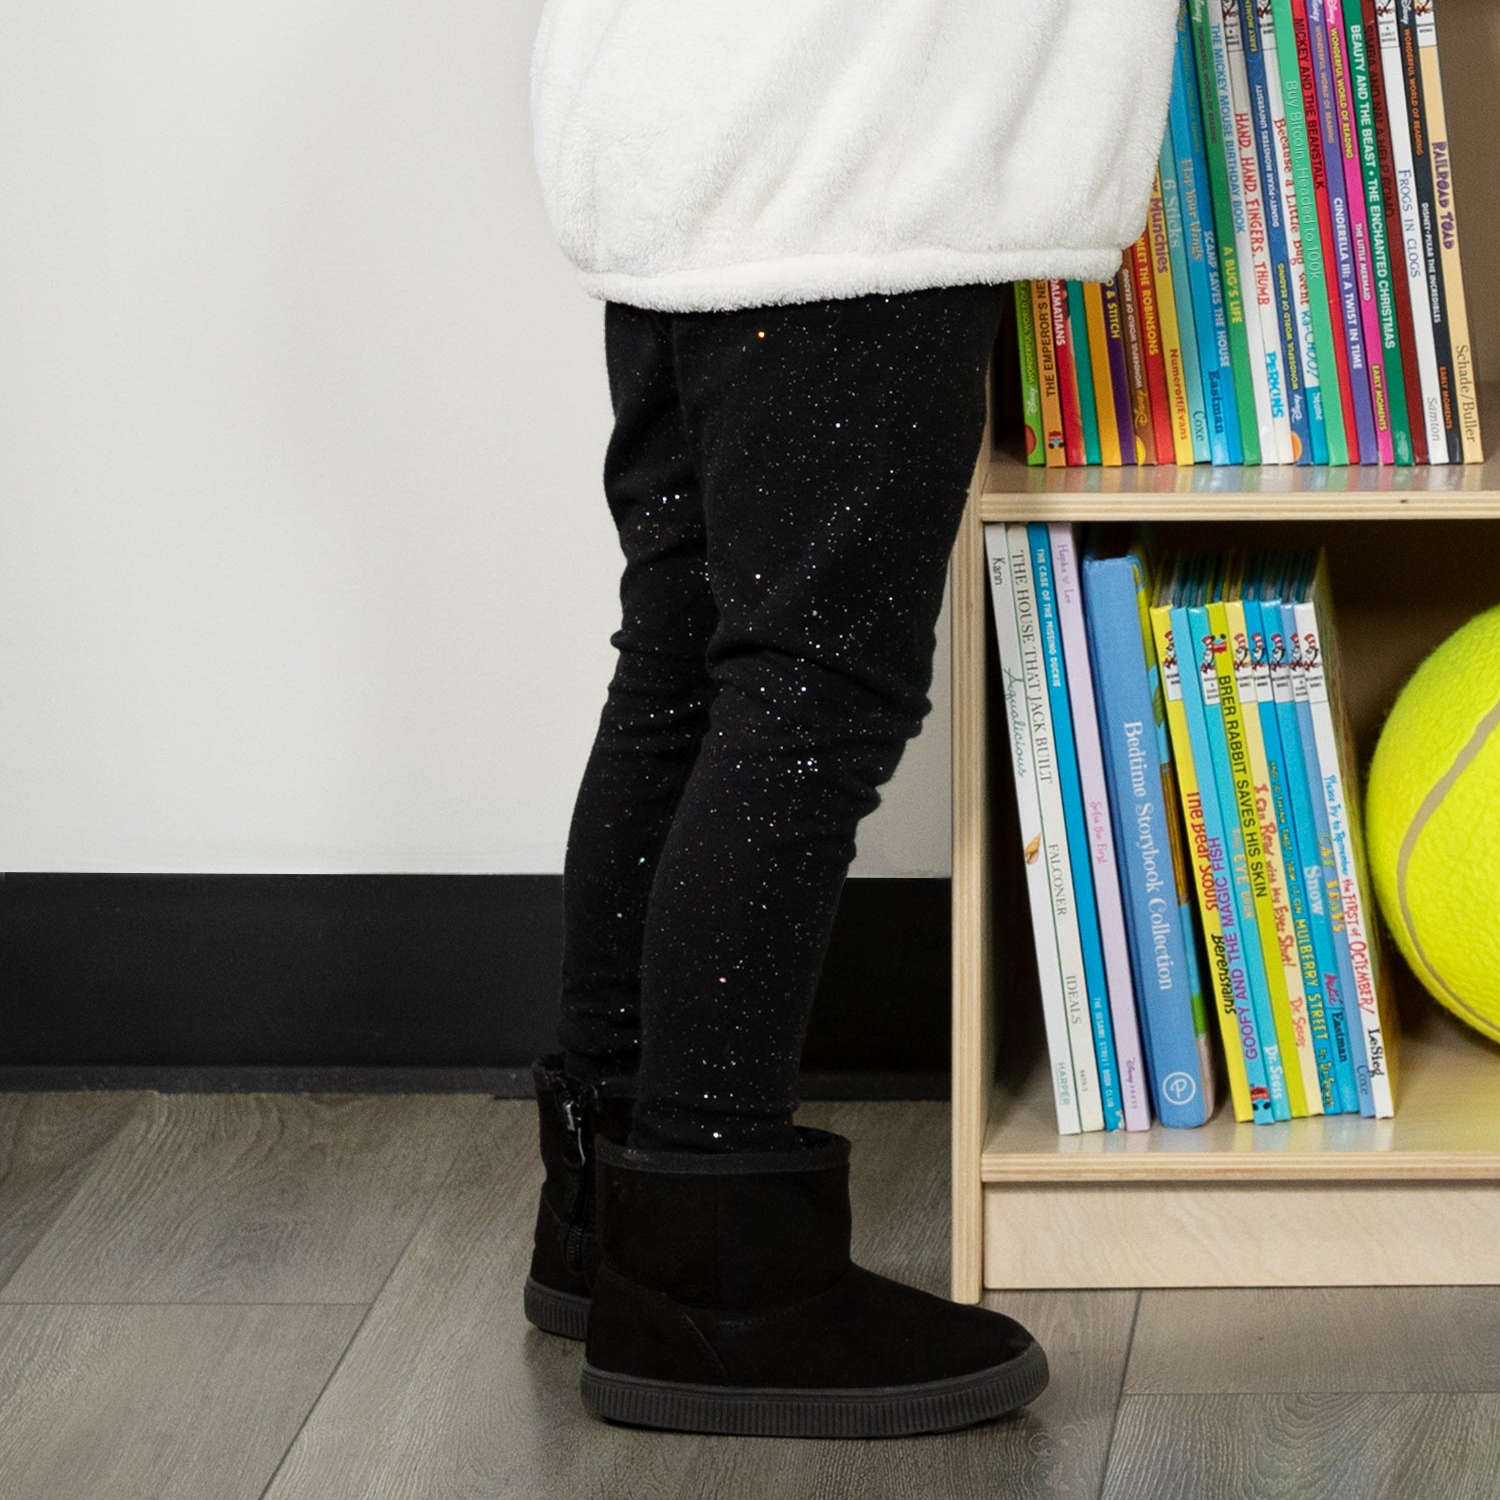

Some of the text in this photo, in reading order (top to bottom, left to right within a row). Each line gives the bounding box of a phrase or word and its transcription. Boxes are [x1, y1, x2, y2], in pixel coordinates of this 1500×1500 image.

[1210, 24, 1246, 234] THE MICKEY MOUSE BIRTHDAY BOOK
[1294, 18, 1325, 190] MICKEY AND THE BEANSTALK
[1273, 117, 1293, 174] Because
[1284, 79, 1299, 109] Buy
[1304, 226, 1317, 242] to
[1285, 192, 1300, 233] Little
[1349, 24, 1397, 349] BEAUTY AND THE BEAST THE ENCHANTED CHRISTMAS
[1431, 141, 1455, 250] RAILROAD TOAD
[1149, 197, 1169, 273] Munchies
[1164, 195, 1183, 249] Sticks
[1287, 238, 1305, 266] Bug
[1333, 197, 1350, 261] CINDERELLA
[1398, 169, 1421, 278] FROGS IN CLOGS
[1223, 246, 1242, 324] A BUG'S LIFE
[1296, 273, 1309, 305] went
[1342, 280, 1353, 290] A
[1354, 223, 1372, 301] THE LITTLE MERMAID
[1107, 302, 1121, 339] STITCH
[1135, 237, 1158, 356] MEET THE ROBINSONS
[1204, 230, 1230, 368] SCAMP SAVES THE HOUSE
[1344, 292, 1358, 326] TWIST
[1038, 301, 1056, 397] THE EMPEROR'S
[1348, 328, 1359, 342] IN
[1350, 344, 1363, 370] TIME
[1208, 370, 1226, 435] Eastman
[1265, 351, 1285, 419] PERKINS
[1455, 344, 1478, 443] Schade/Buller
[1192, 410, 1208, 442] Coxe
[992, 556, 1007, 586] Kann
[1011, 550, 1053, 781] THE HOUSE THAT JACK BUILT
[1003, 667, 1029, 777] Aqualicious
[1217, 674, 1268, 898] BRER RABBIT SAVES HIS SKIN
[1048, 843, 1068, 916] FALCONER
[1123, 720, 1175, 991] Bedtime Storybook Collection
[1342, 878, 1355, 892] the
[1303, 864, 1325, 917] Snow
[1342, 893, 1360, 926] FIRST
[1207, 836, 1259, 1061] GOOFY AND THE MAGIC FISH
[1295, 918, 1318, 988] MULBERRY
[1307, 992, 1328, 1040] STREET
[1065, 975, 1081, 1025] IDEALS
[1056, 1061, 1070, 1106] HARPER
[1269, 1064, 1283, 1100] Seuss
[1355, 1064, 1369, 1096] Coxe
[1367, 1028, 1385, 1077] LeSieg
